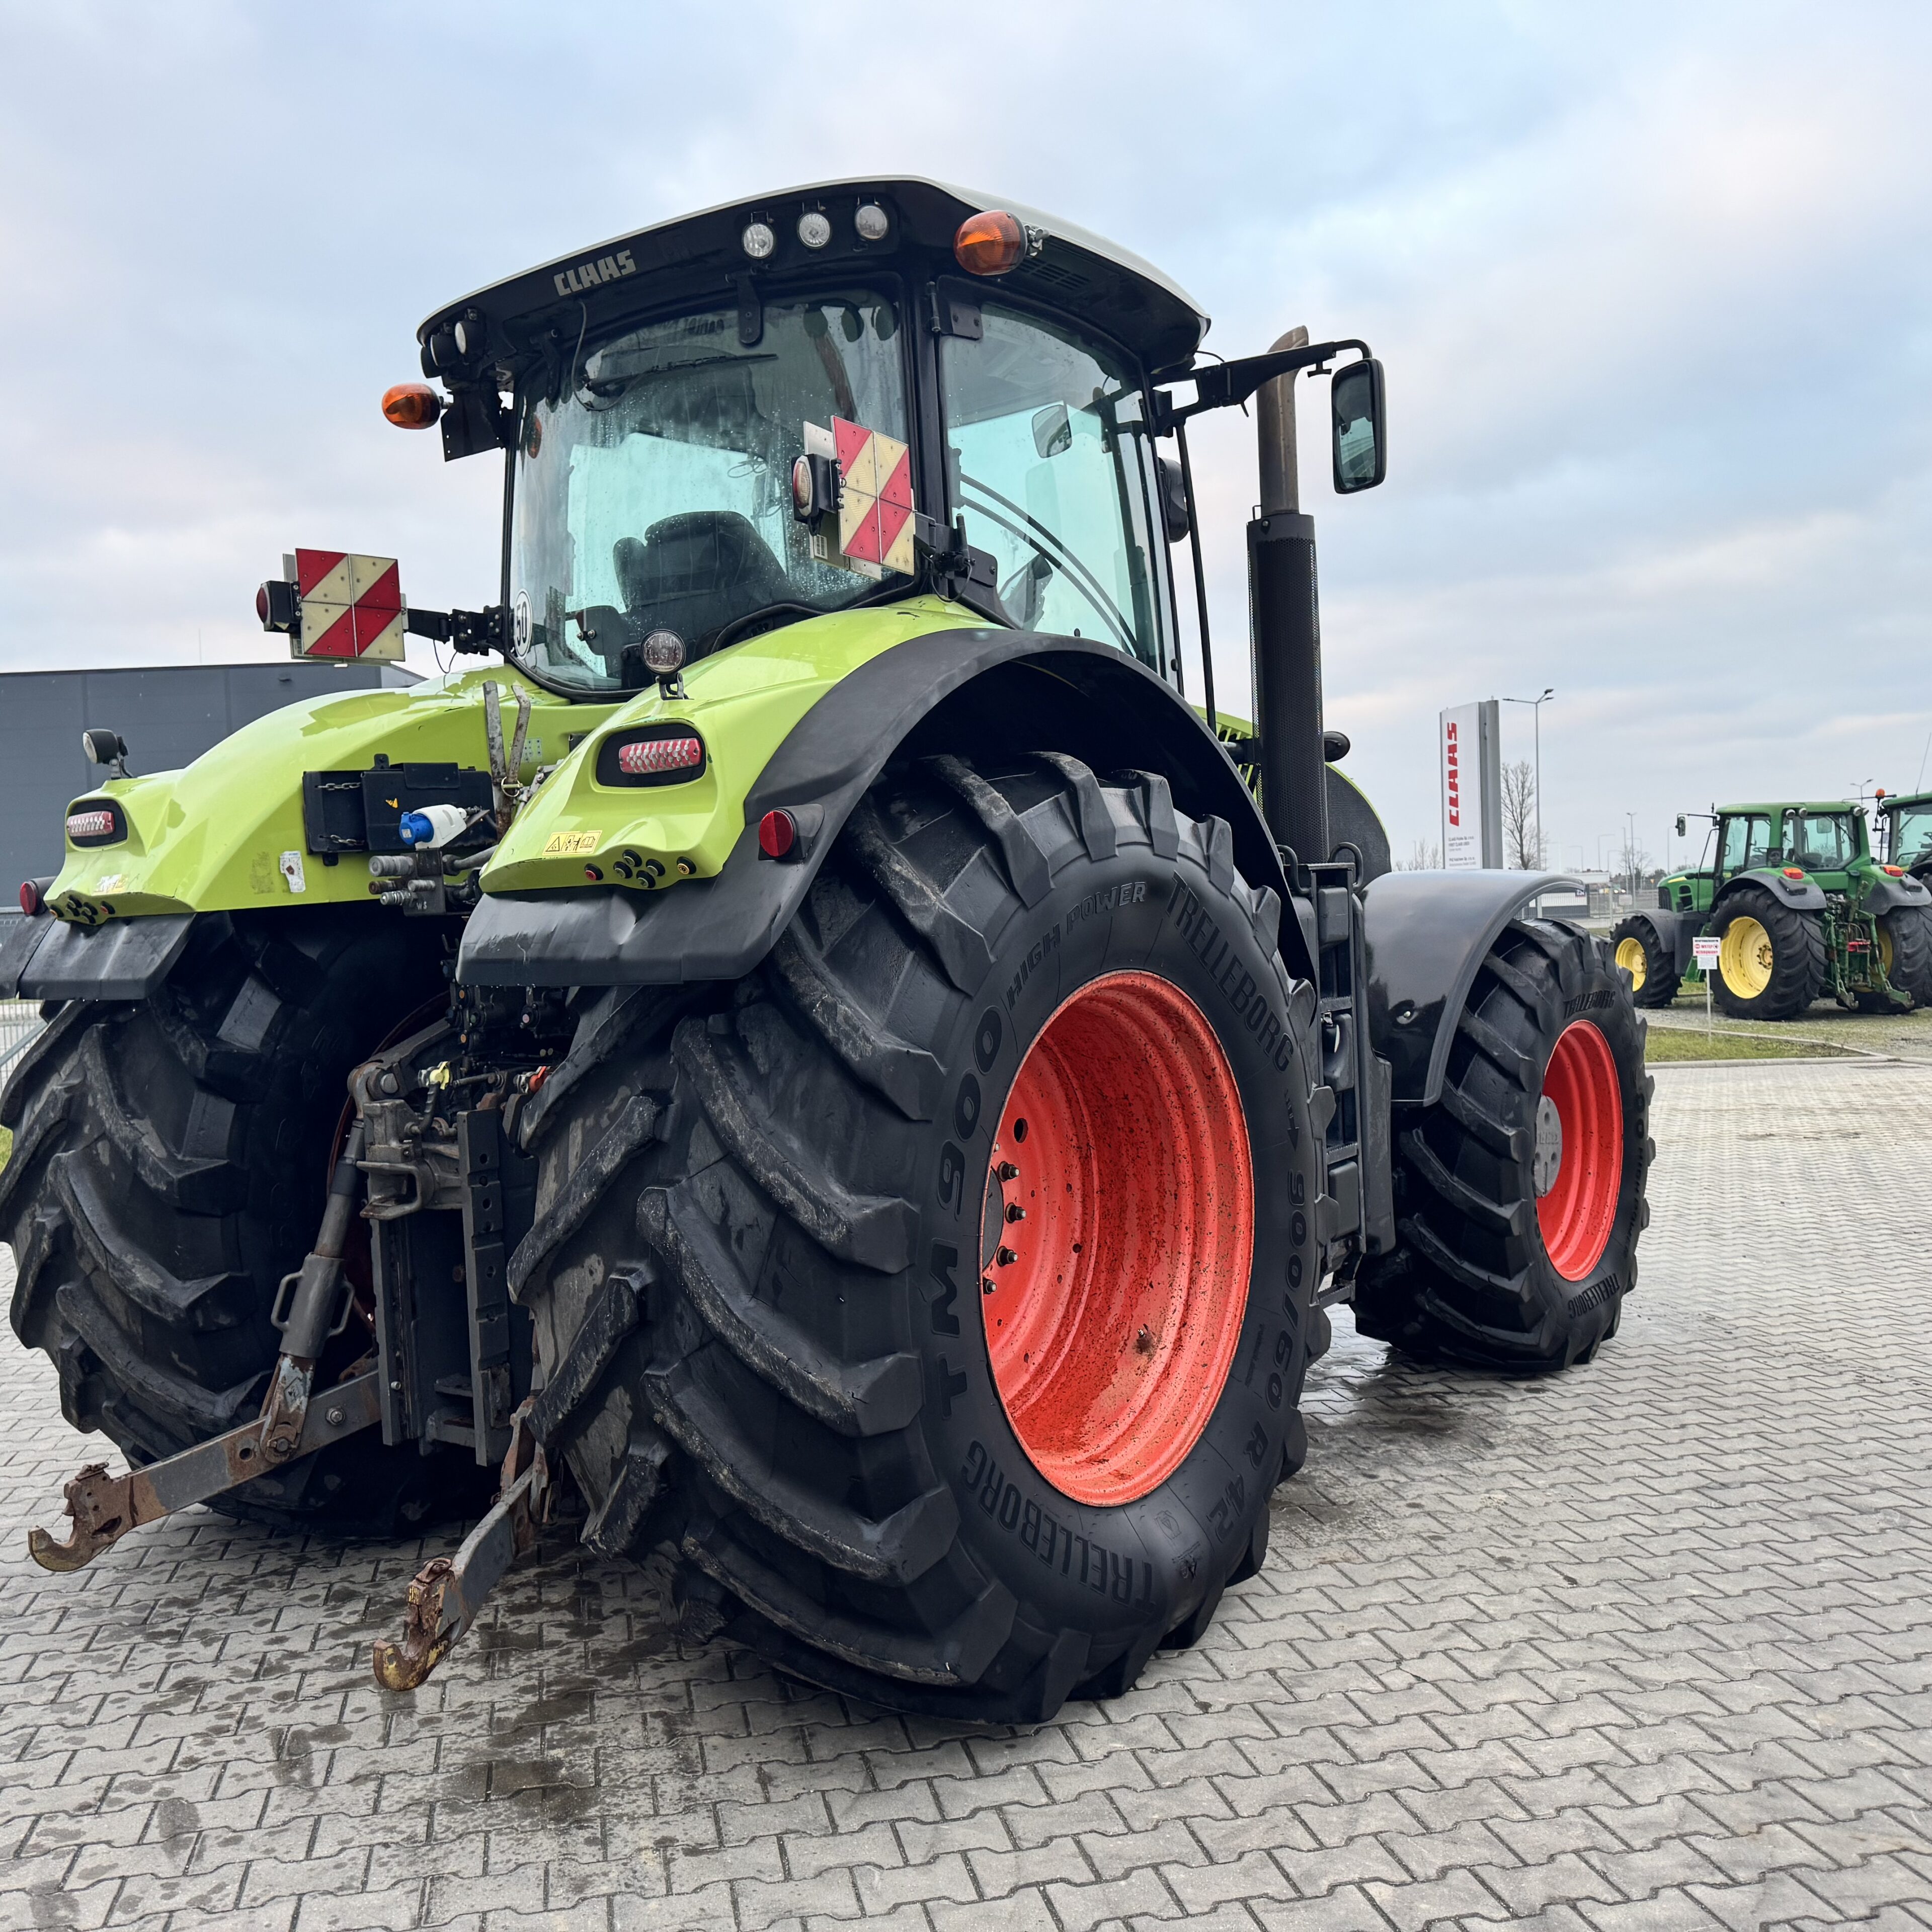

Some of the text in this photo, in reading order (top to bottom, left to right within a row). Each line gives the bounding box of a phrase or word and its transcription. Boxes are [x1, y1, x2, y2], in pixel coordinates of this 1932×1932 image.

[554, 250, 636, 296] CLAAS
[517, 601, 527, 647] 50
[1447, 722, 1459, 826] CLAAS
[1007, 923, 1061, 1009] HIGH
[1066, 881, 1147, 935] POWER
[1164, 870, 1295, 1073] TRELLEBORG
[1563, 990, 1616, 1020] TRELLEBORG
[1568, 1272, 1620, 1319] TRELLEBORG
[960, 1440, 1156, 1613] TRELLEBORG
